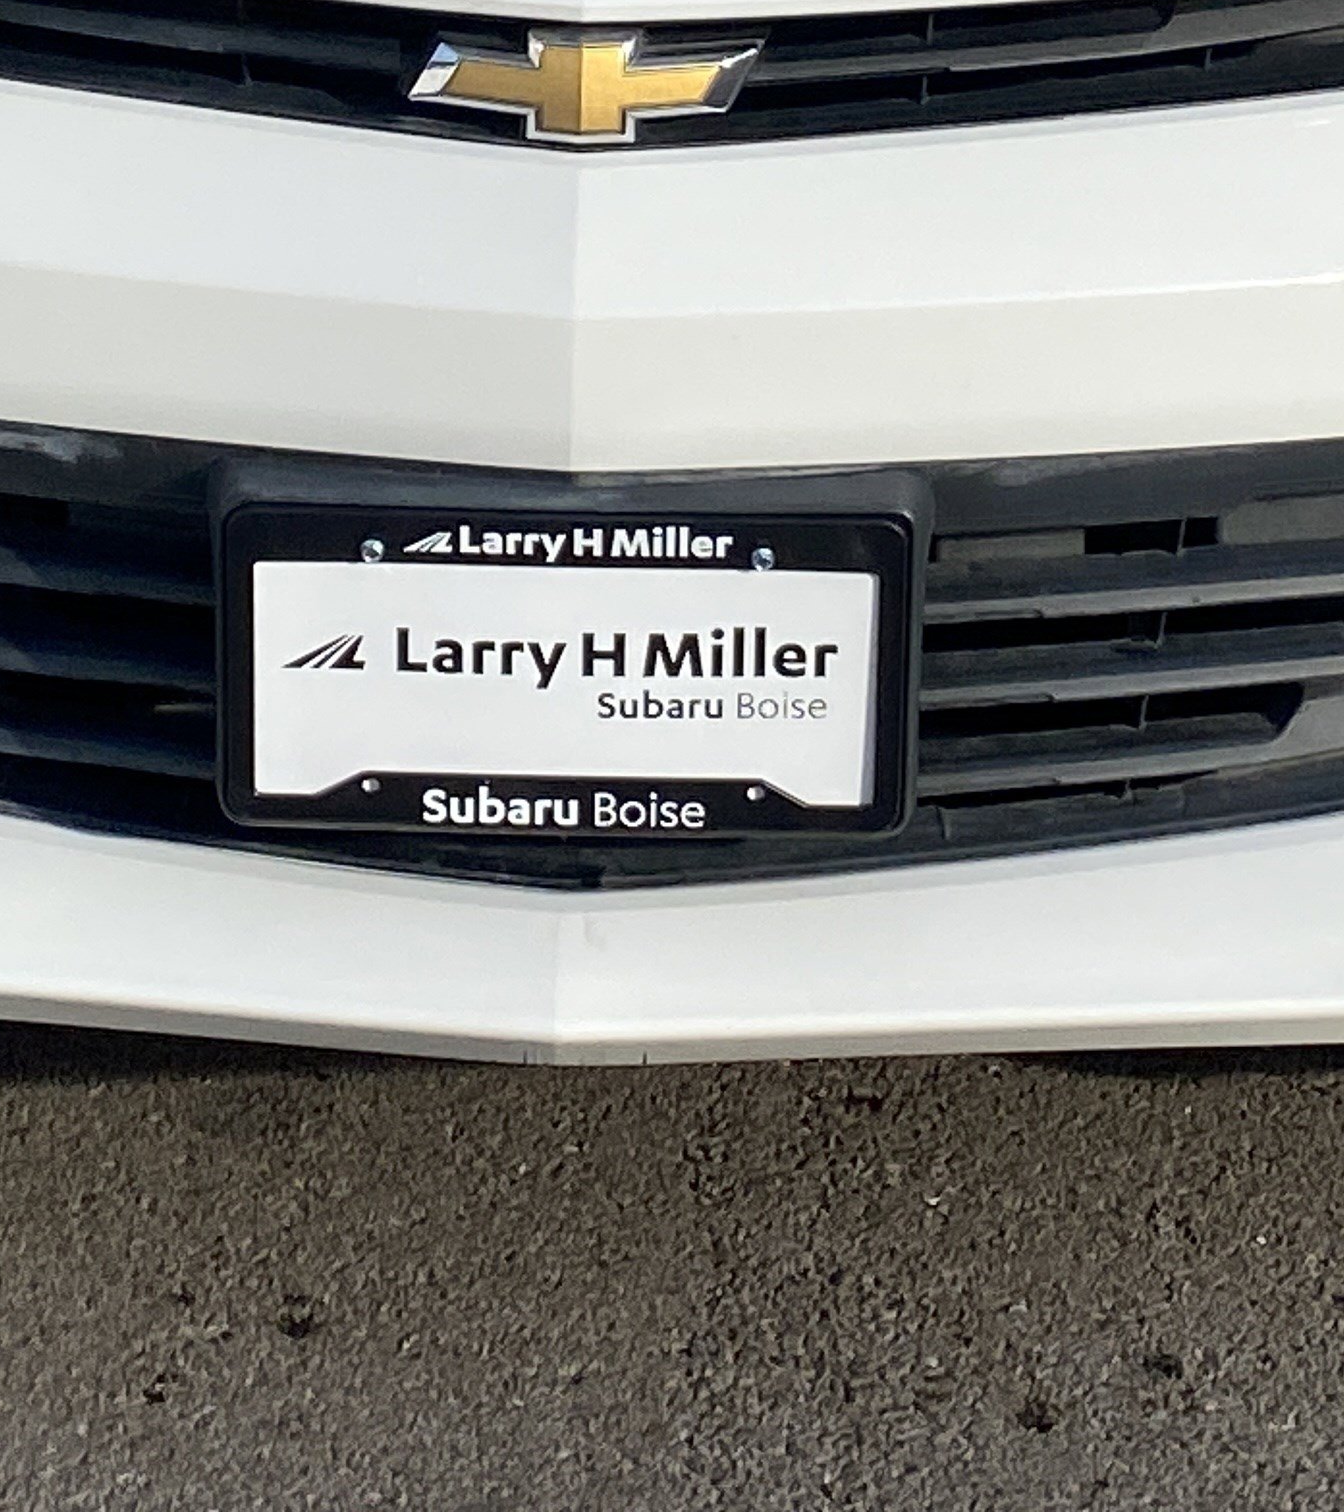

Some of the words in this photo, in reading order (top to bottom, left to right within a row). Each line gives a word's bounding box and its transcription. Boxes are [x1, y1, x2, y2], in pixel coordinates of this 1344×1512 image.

[459, 524, 567, 563] Larry
[573, 528, 604, 557] H
[610, 525, 734, 559] Miller
[396, 627, 567, 690] Larry
[582, 632, 626, 677] H
[642, 627, 839, 678] Miller
[597, 691, 723, 720] Subaru
[736, 691, 828, 720] Boise
[422, 785, 579, 827] Subaru
[593, 791, 706, 829] Boise
